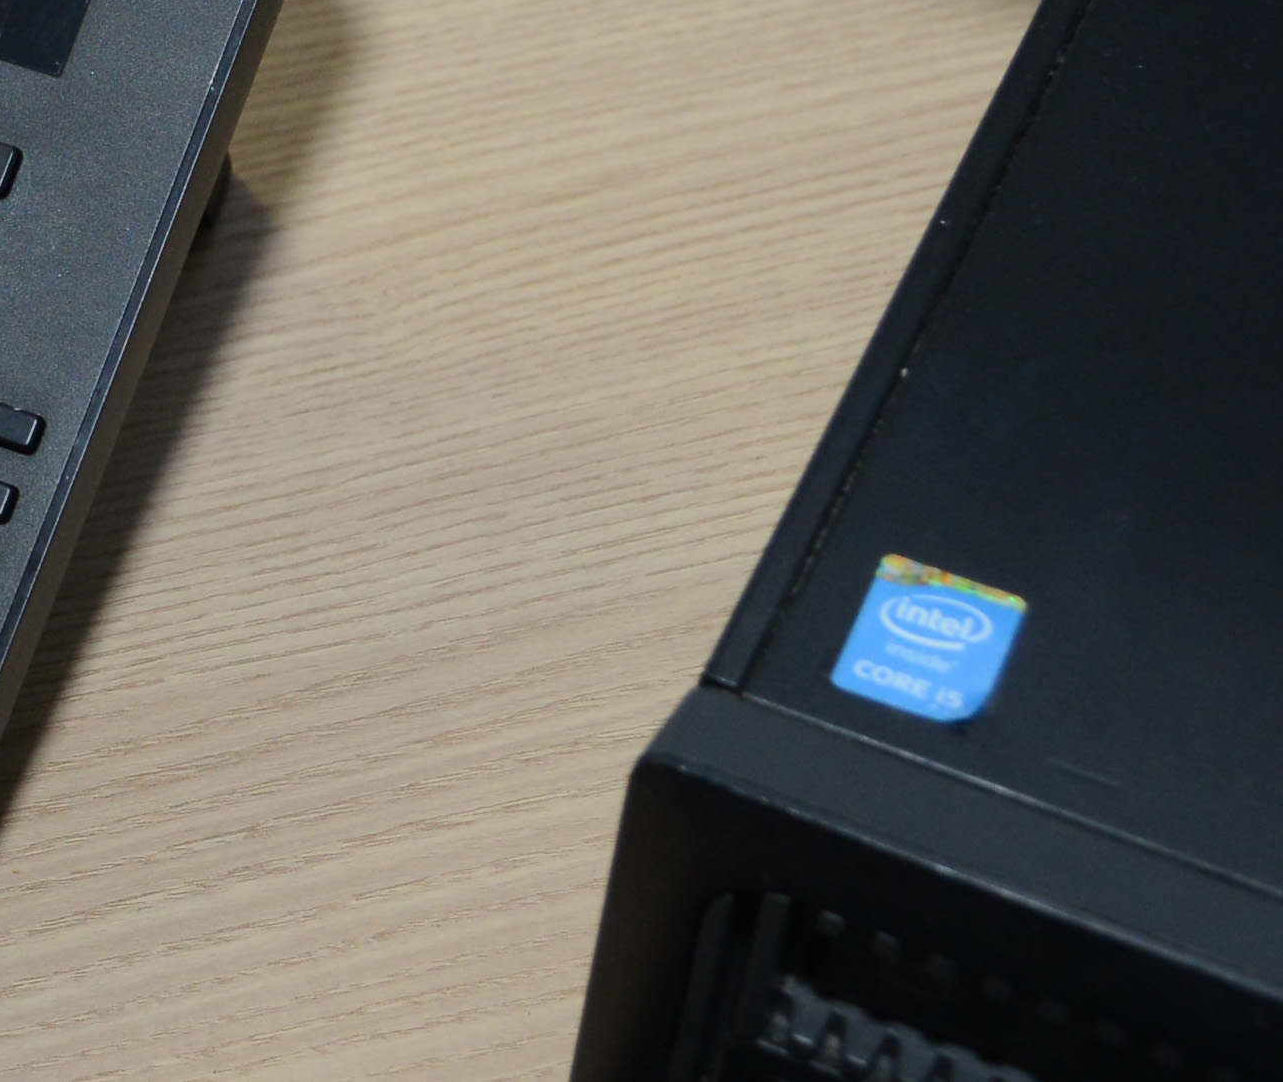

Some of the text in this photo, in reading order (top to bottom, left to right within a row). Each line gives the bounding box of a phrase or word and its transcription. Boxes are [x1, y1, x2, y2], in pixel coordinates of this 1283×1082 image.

[895, 596, 977, 639] intel
[853, 659, 964, 709] CORE i5
